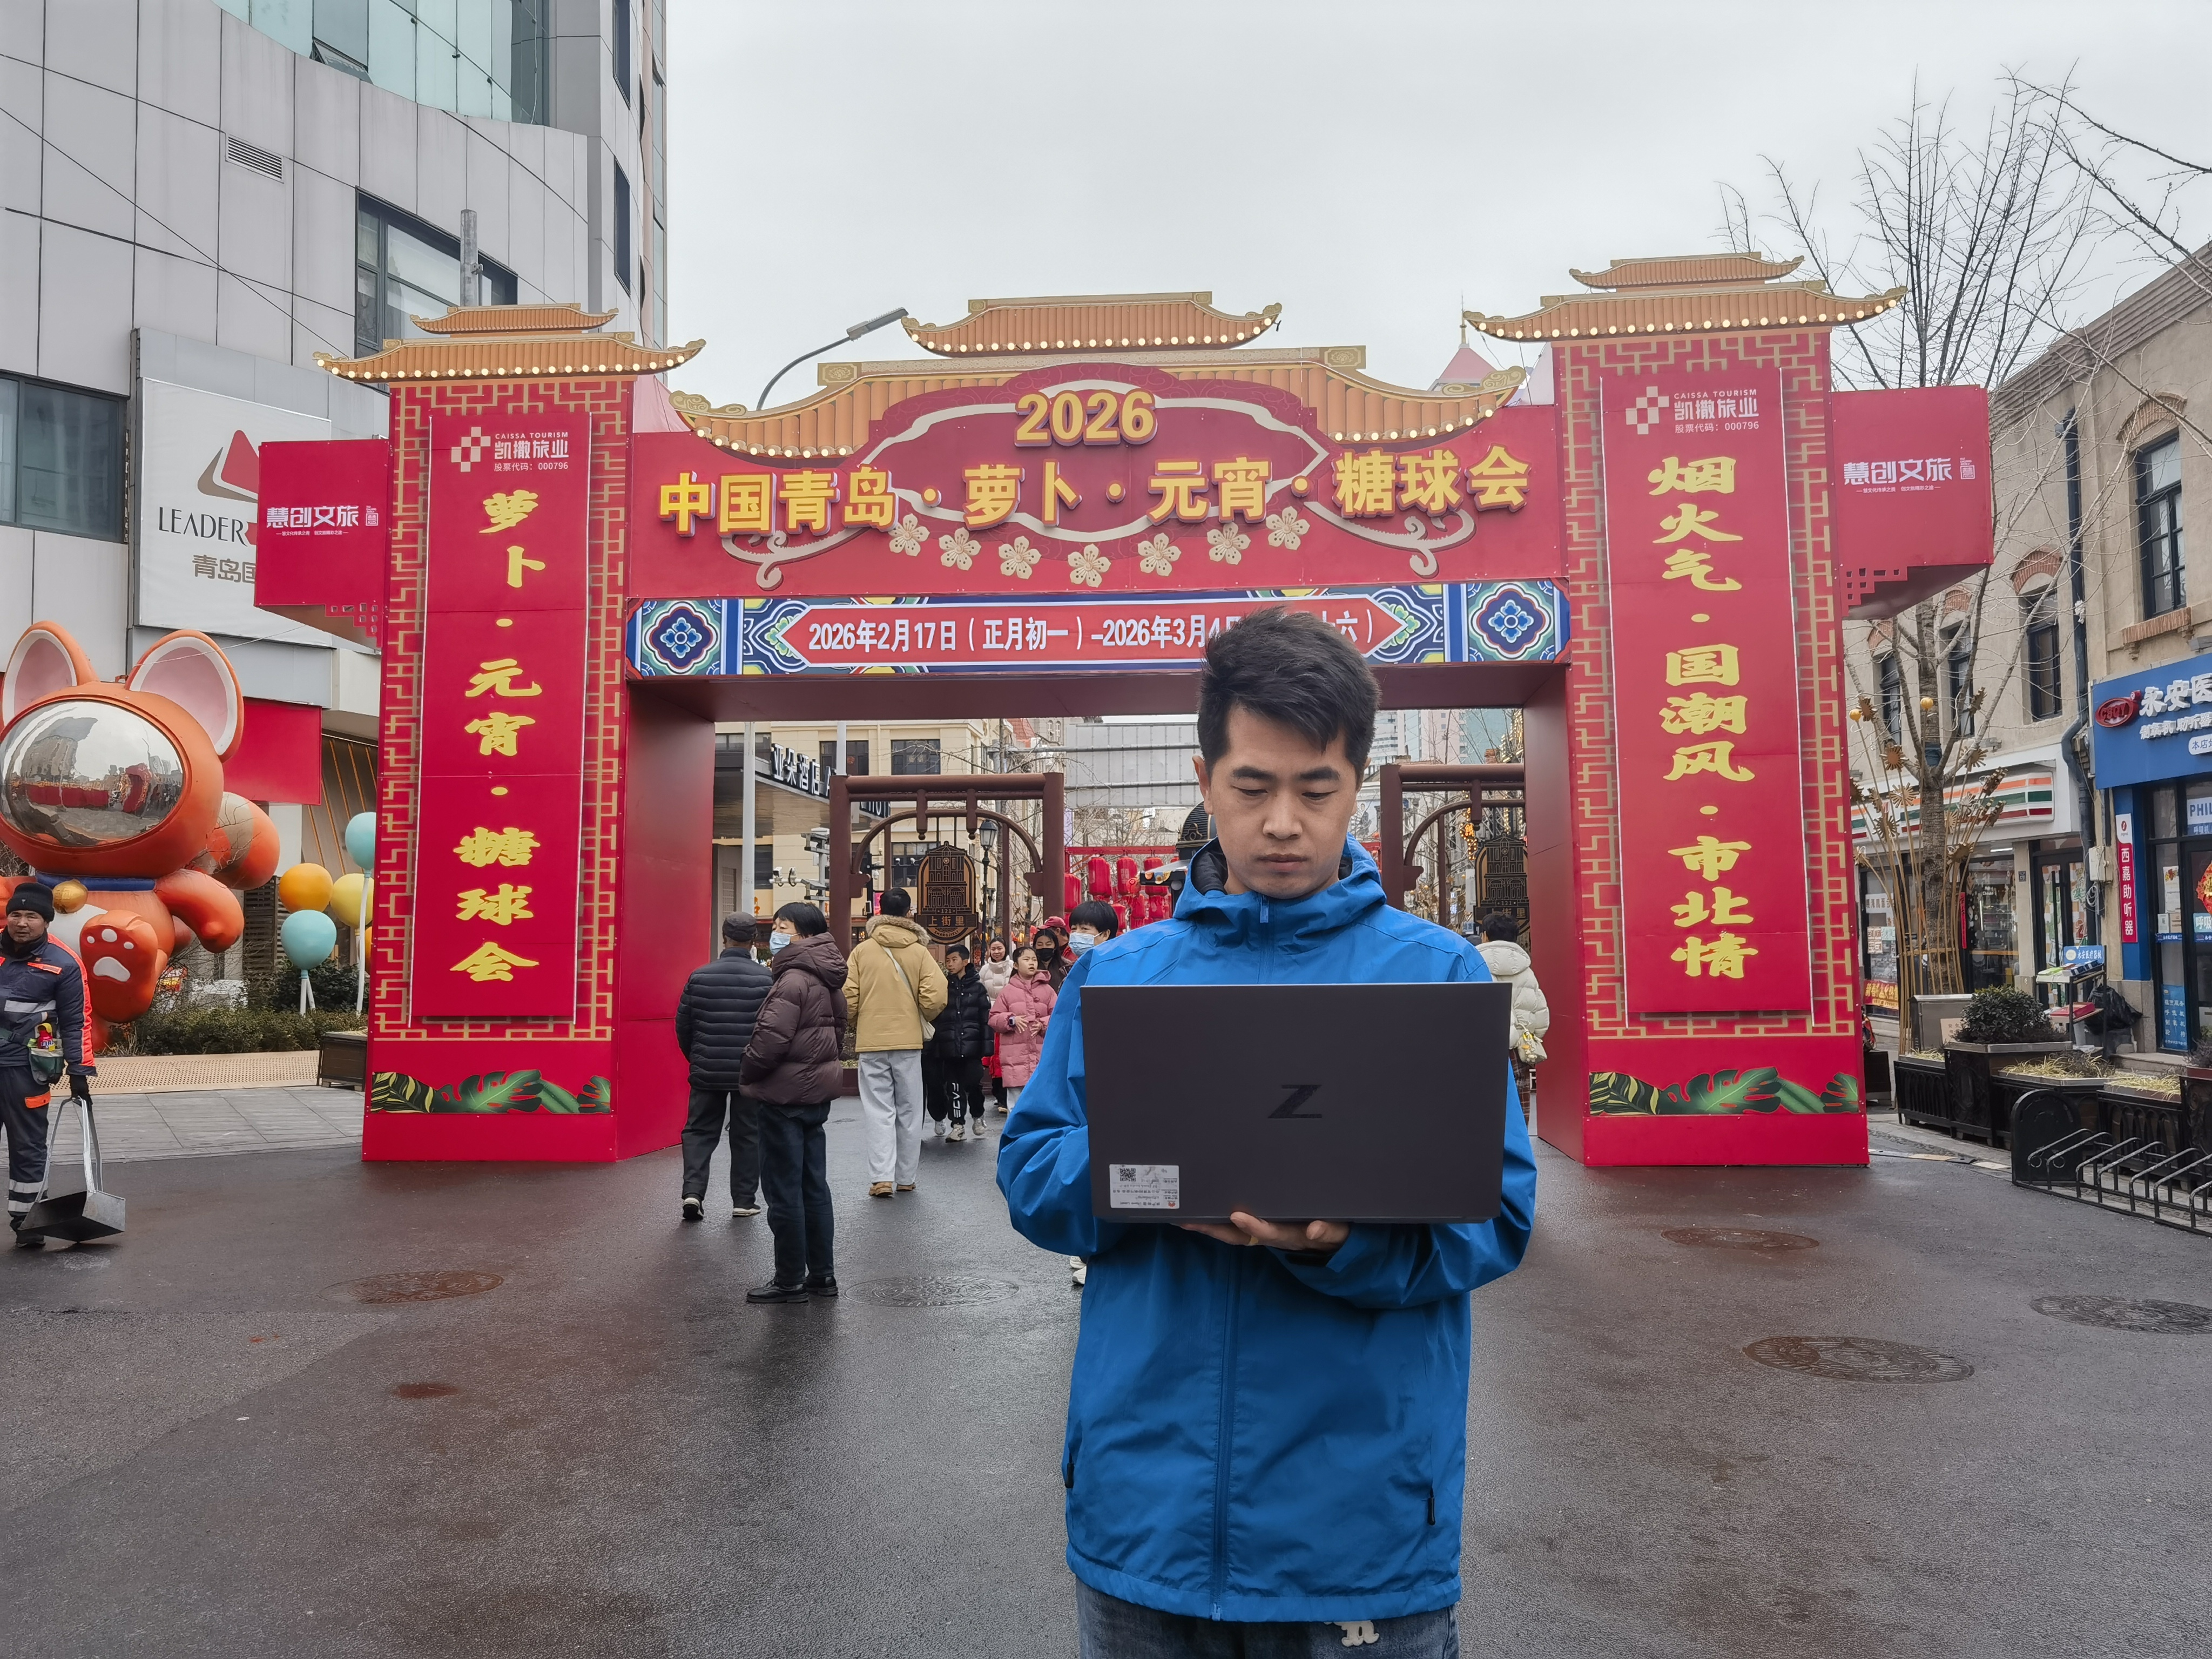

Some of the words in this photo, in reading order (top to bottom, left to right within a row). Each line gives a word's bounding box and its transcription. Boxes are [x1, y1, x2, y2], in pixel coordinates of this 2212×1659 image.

[1674, 391, 1709, 400] CAISSA
[1712, 388, 1757, 398] TOURISM
[1015, 388, 1157, 447] 2026
[1674, 397, 1759, 421] 凯撒旅业
[494, 441, 569, 460] 凯撒旅业
[1844, 457, 1953, 485] 慧创文旅
[159, 507, 248, 547] LEADER
[266, 505, 360, 528] 慧创文旅
[772, 743, 821, 796] 亚朵酒店
[2121, 847, 2134, 935] 西嘉助听器
[928, 915, 965, 927] 上街里
[1267, 1084, 1322, 1119] Z
